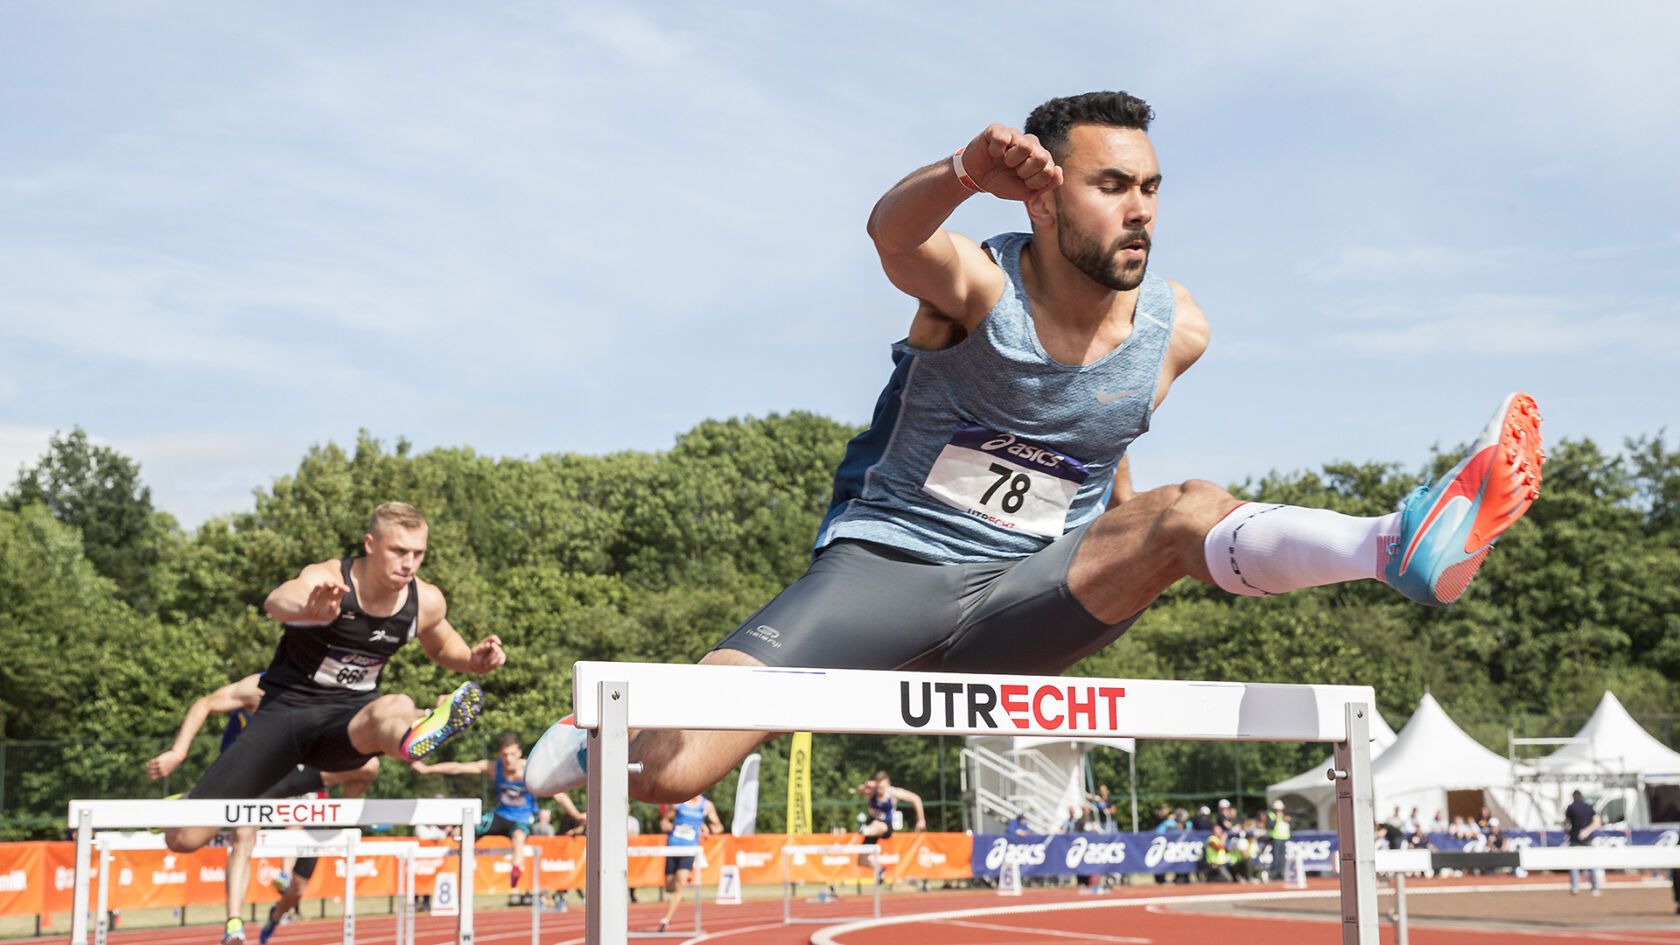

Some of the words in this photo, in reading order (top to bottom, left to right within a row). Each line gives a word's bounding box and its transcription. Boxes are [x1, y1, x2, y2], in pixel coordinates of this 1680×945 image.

[1007, 441, 1065, 468] asics
[979, 462, 1031, 514] 78
[900, 681, 1125, 730] UTRECHT
[225, 804, 341, 823] UTRECHT
[1083, 842, 1126, 864] asics
[1162, 840, 1204, 863] asics
[439, 882, 452, 905] 8
[723, 873, 734, 895] 7
